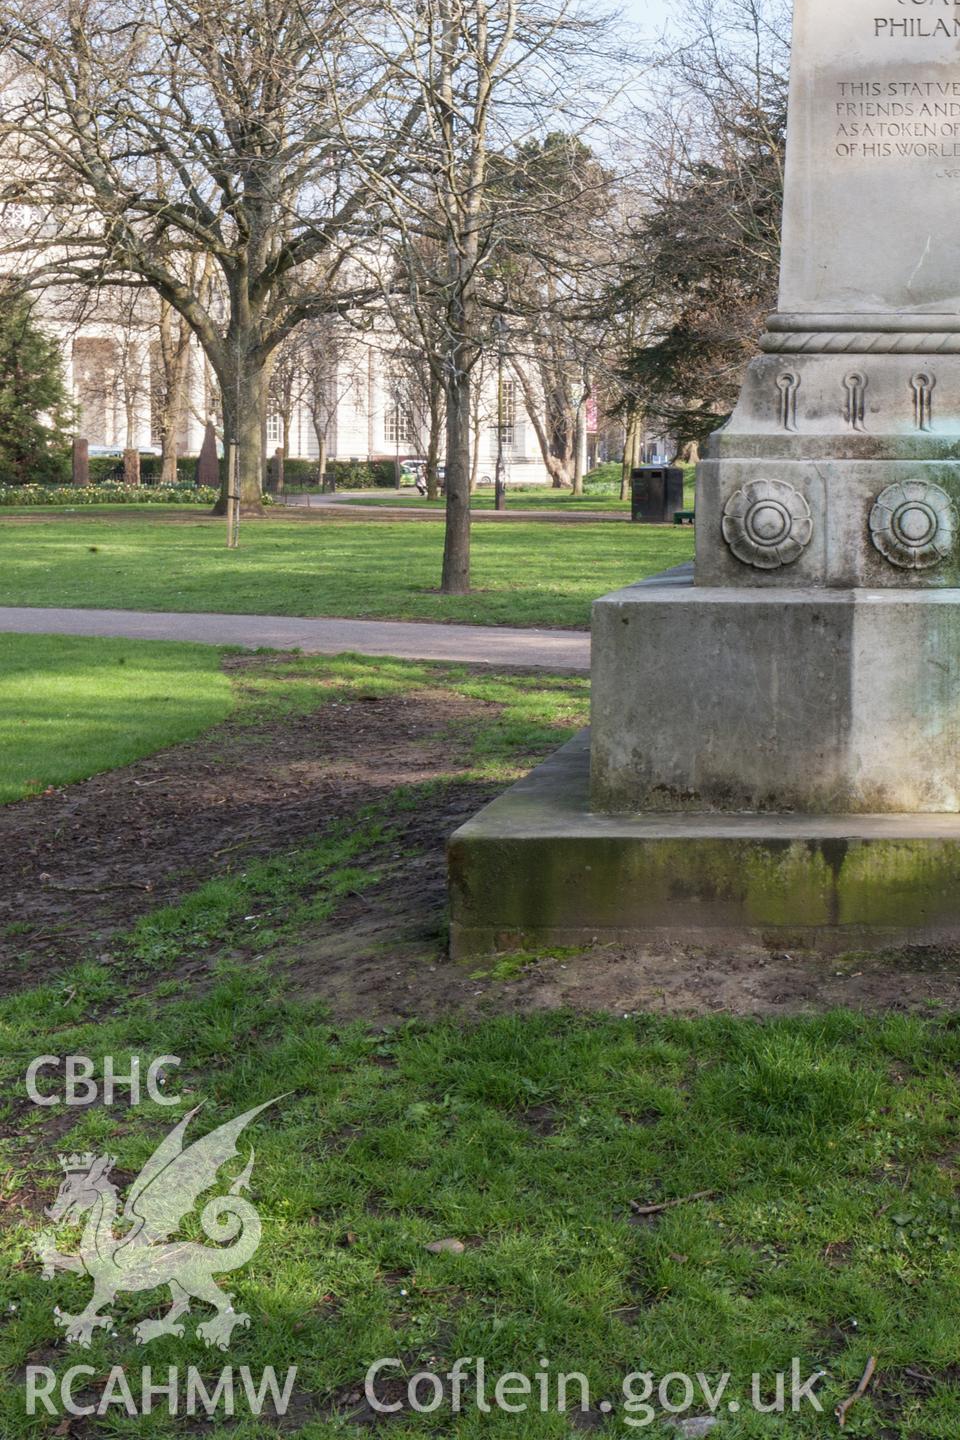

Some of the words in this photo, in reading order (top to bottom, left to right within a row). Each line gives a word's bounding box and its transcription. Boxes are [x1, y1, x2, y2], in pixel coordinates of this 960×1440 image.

[837, 82, 882, 96] THIS
[836, 102, 914, 117] FRIENDS
[836, 122, 859, 137] AS
[861, 122, 874, 137] A
[876, 122, 937, 137] TOKEN
[940, 122, 960, 137] OF
[835, 143, 858, 157] OF
[862, 143, 892, 157] HIS
